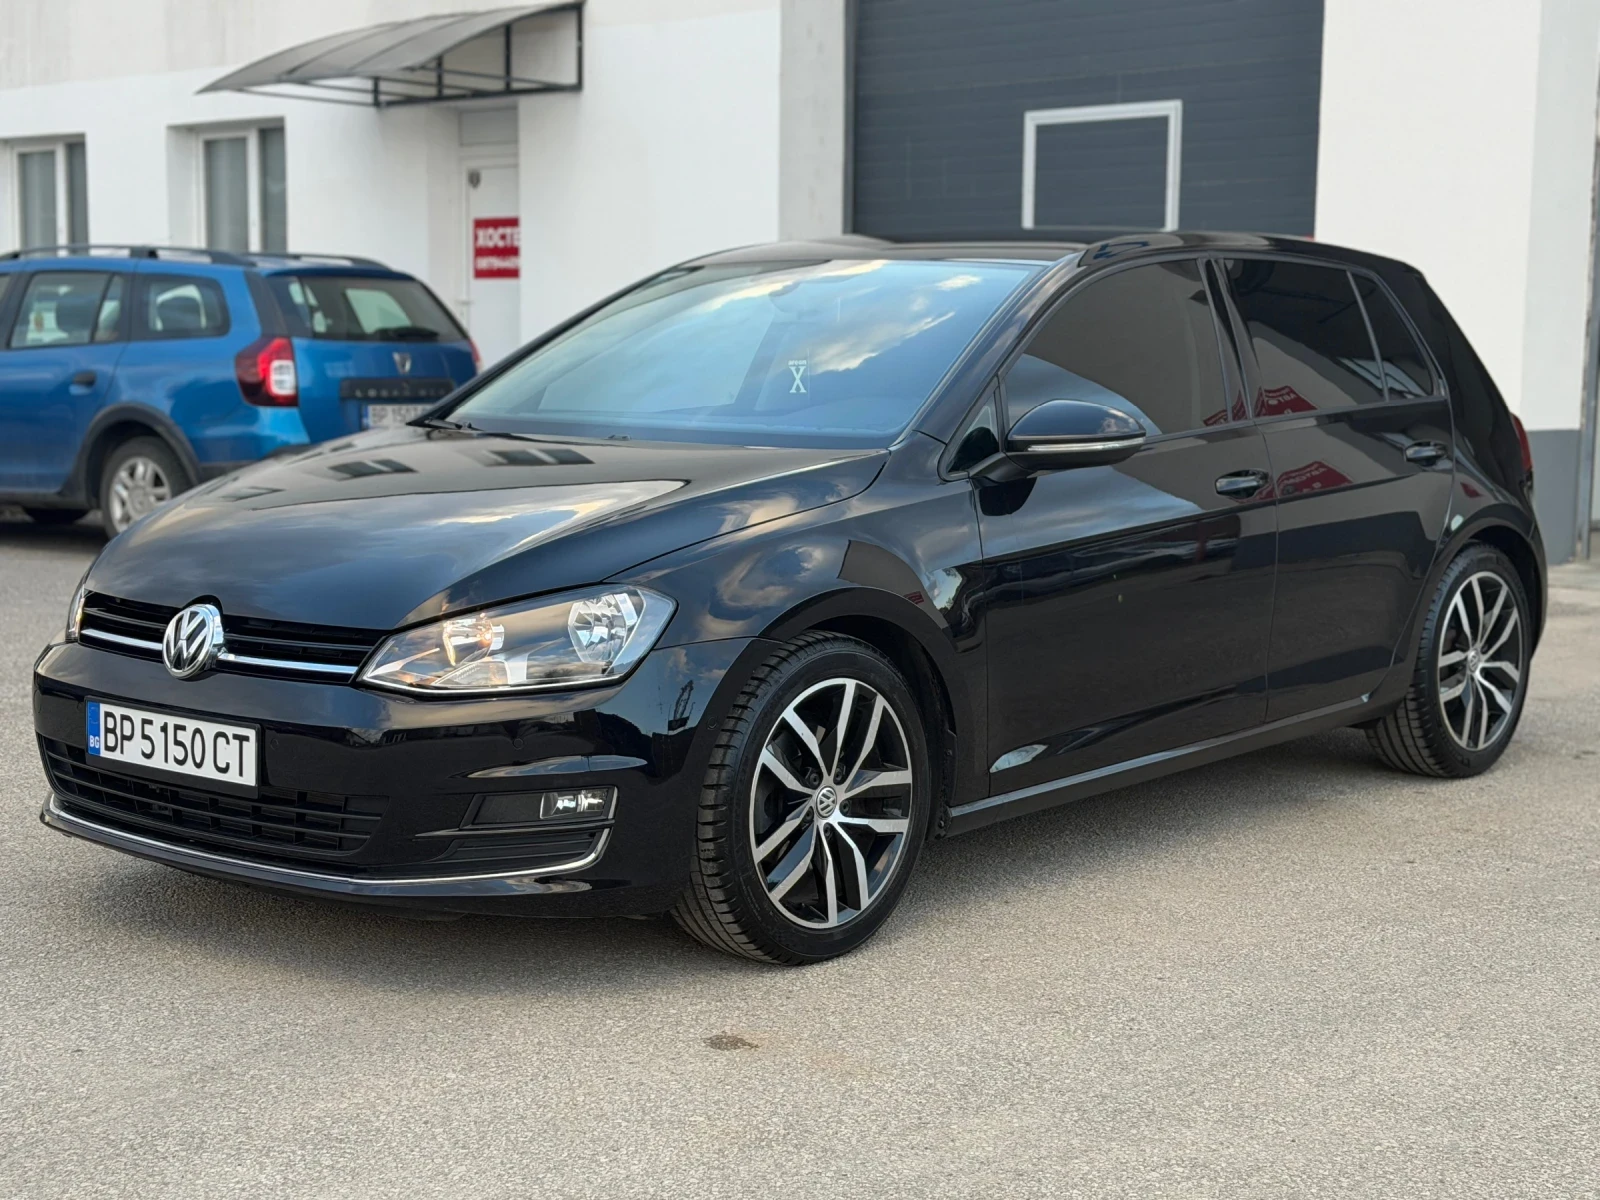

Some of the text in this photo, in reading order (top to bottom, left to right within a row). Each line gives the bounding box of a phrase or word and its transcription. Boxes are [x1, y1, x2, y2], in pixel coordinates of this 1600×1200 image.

[89, 734, 100, 749] BG
[103, 710, 250, 778] BP 5150 CT
